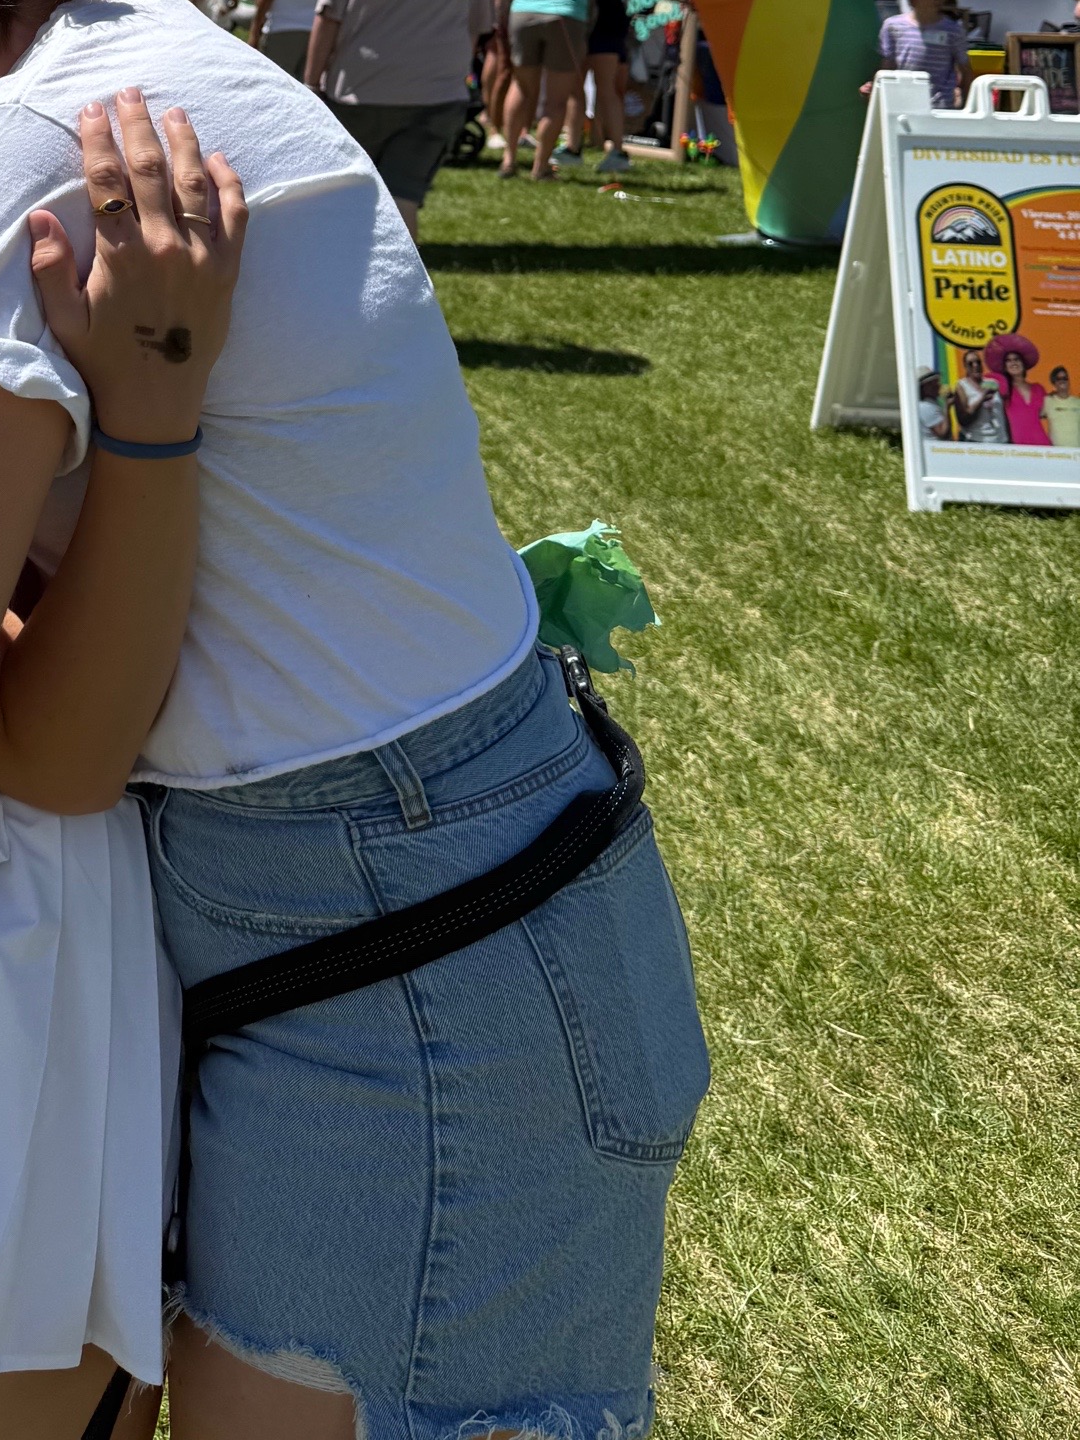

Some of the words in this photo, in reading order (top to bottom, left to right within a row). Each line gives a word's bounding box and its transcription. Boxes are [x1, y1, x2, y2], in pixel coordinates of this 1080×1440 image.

[913, 147, 1023, 164] DIVERSIDAD
[924, 194, 974, 221] MOUNTAIN
[978, 198, 1006, 223] PRIDE
[931, 249, 1007, 268] LATINO
[934, 276, 1010, 301] Pride
[941, 319, 986, 339] Junio
[987, 319, 1008, 336] 20
